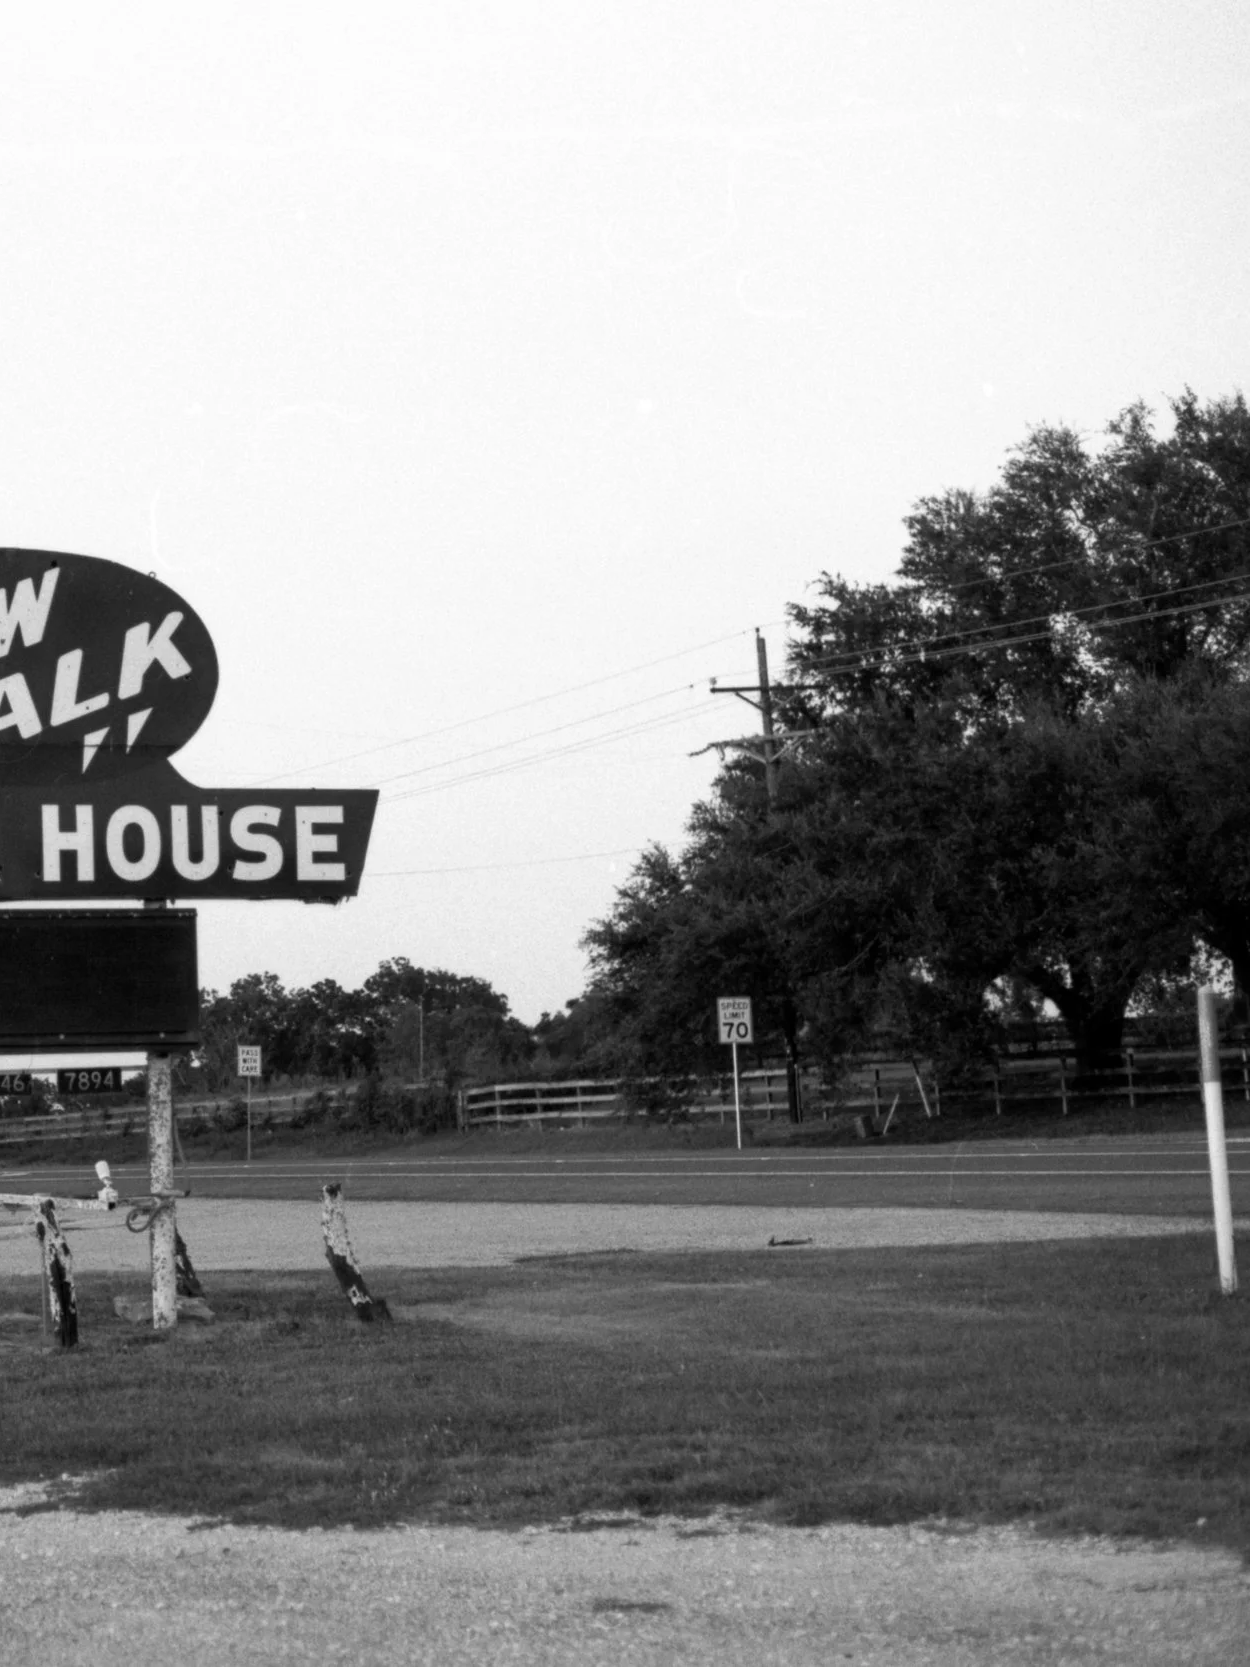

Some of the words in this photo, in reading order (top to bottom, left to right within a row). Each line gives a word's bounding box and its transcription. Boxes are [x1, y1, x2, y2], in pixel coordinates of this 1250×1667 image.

[40, 803, 347, 883] HOUSE
[721, 1001, 748, 1010] SPEED
[724, 1011, 745, 1020] LIMIT
[722, 1022, 748, 1039] 70
[64, 1070, 115, 1091] 7894
